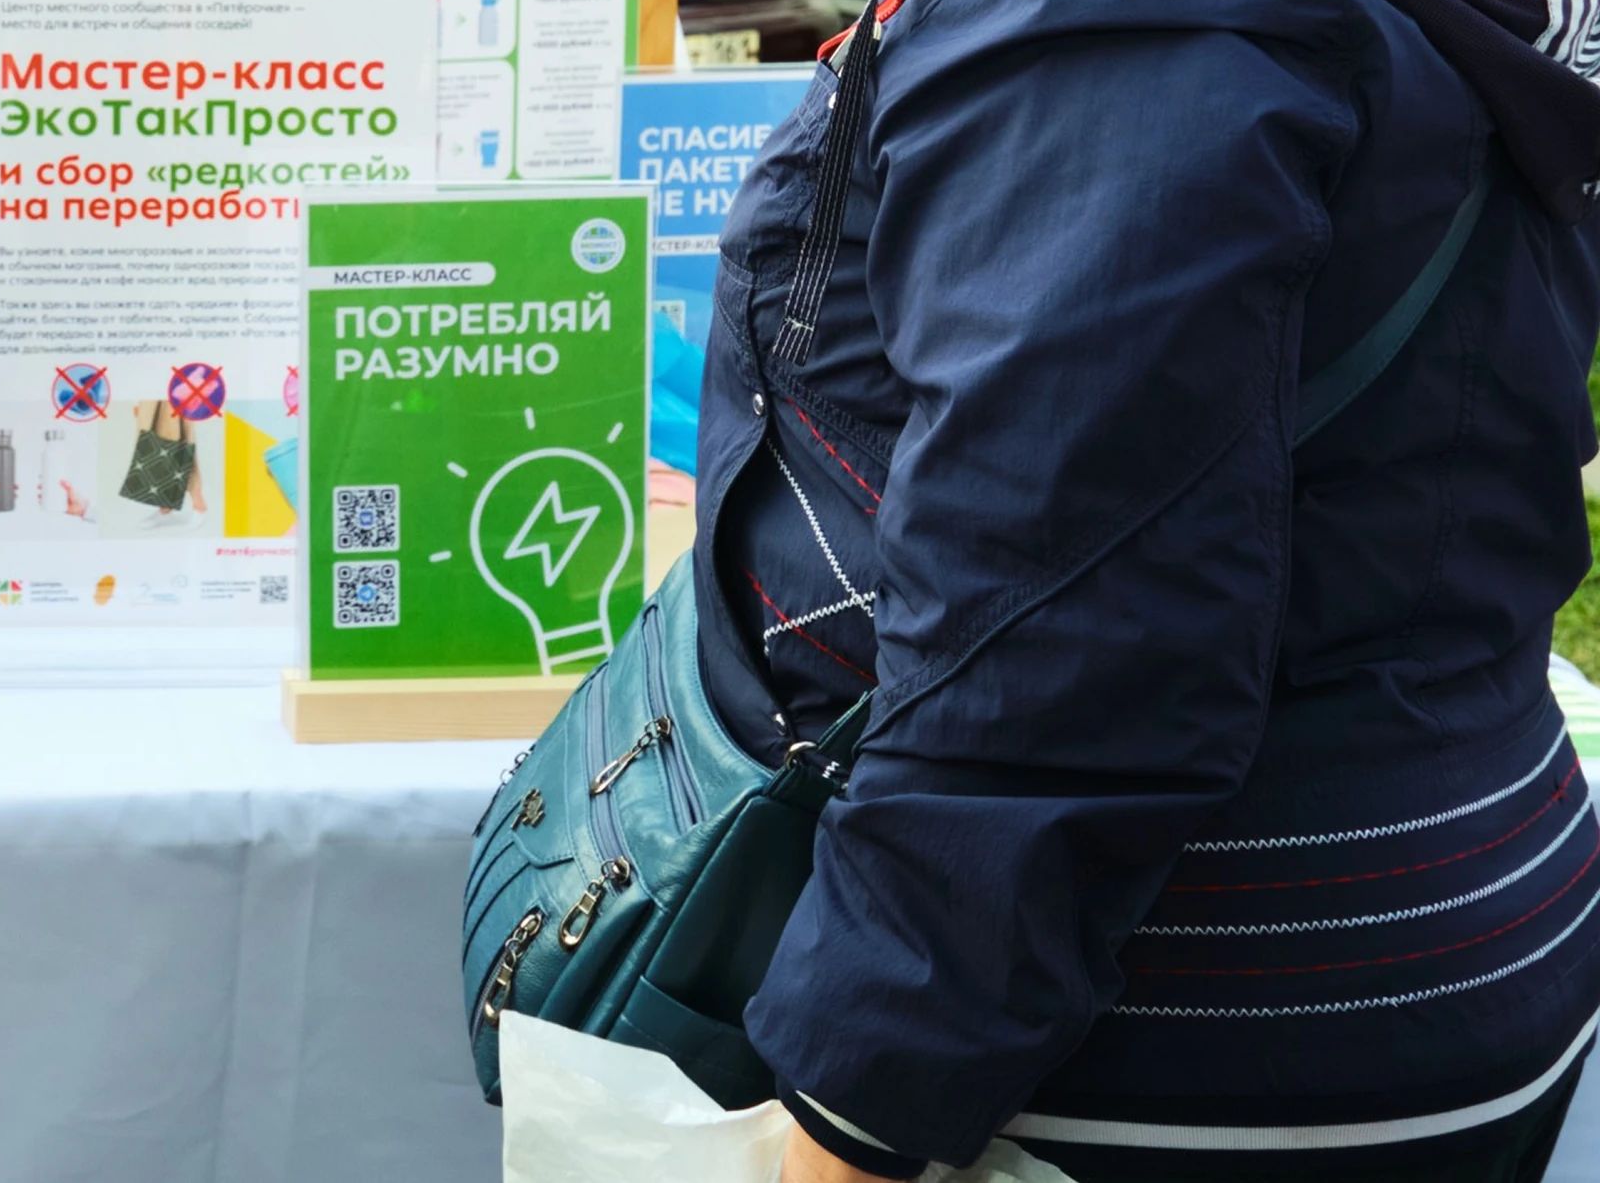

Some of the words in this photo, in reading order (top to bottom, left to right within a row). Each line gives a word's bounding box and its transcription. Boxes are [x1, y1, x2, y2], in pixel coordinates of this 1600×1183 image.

[1, 1, 44, 14] Центр
[48, 3, 110, 13] местного
[113, 0, 192, 14] сообщества
[206, 1, 291, 15] «Пятёрочке»
[1, 20, 41, 30] место
[45, 20, 68, 30] для
[72, 20, 118, 32] встреч
[134, 18, 192, 30] общения
[0, 53, 385, 100] Мастер-класс
[0, 99, 398, 146] ЭкоТакПросто
[0, 162, 22, 185] и
[36, 156, 134, 192] сбор
[147, 155, 411, 192] «редкостей»
[0, 197, 48, 220] на
[334, 267, 472, 284] МАСТЕР-КЛАСС
[335, 291, 612, 339] ПОТРЕБЛЯЙ
[335, 342, 560, 381] РАЗУМНО
